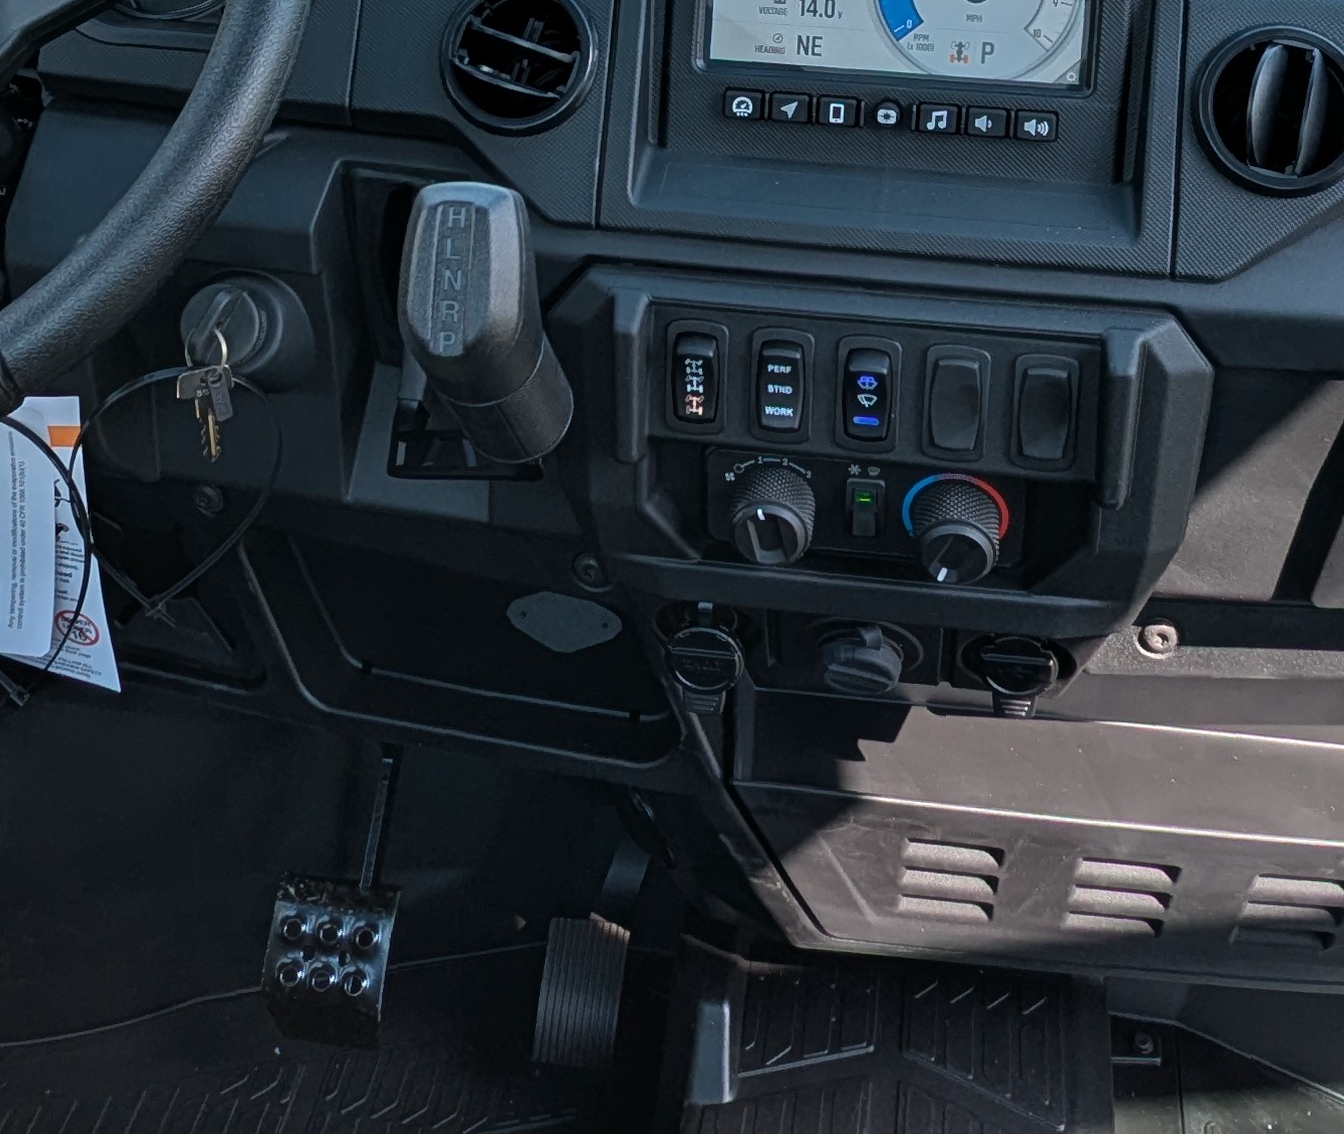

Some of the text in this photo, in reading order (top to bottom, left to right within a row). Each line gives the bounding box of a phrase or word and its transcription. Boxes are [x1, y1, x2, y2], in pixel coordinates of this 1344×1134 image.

[759, 6, 788, 16] VOLTAGE
[966, 14, 983, 23] MPH
[754, 34, 824, 57] HEADING NE
[913, 33, 929, 42] RPM
[981, 41, 995, 65] P
[448, 207, 466, 229] H
[445, 237, 460, 260] L
[443, 269, 462, 291] N
[439, 300, 459, 323] R
[438, 332, 456, 353] P
[767, 364, 792, 374] PERF
[764, 405, 794, 417] WORK
